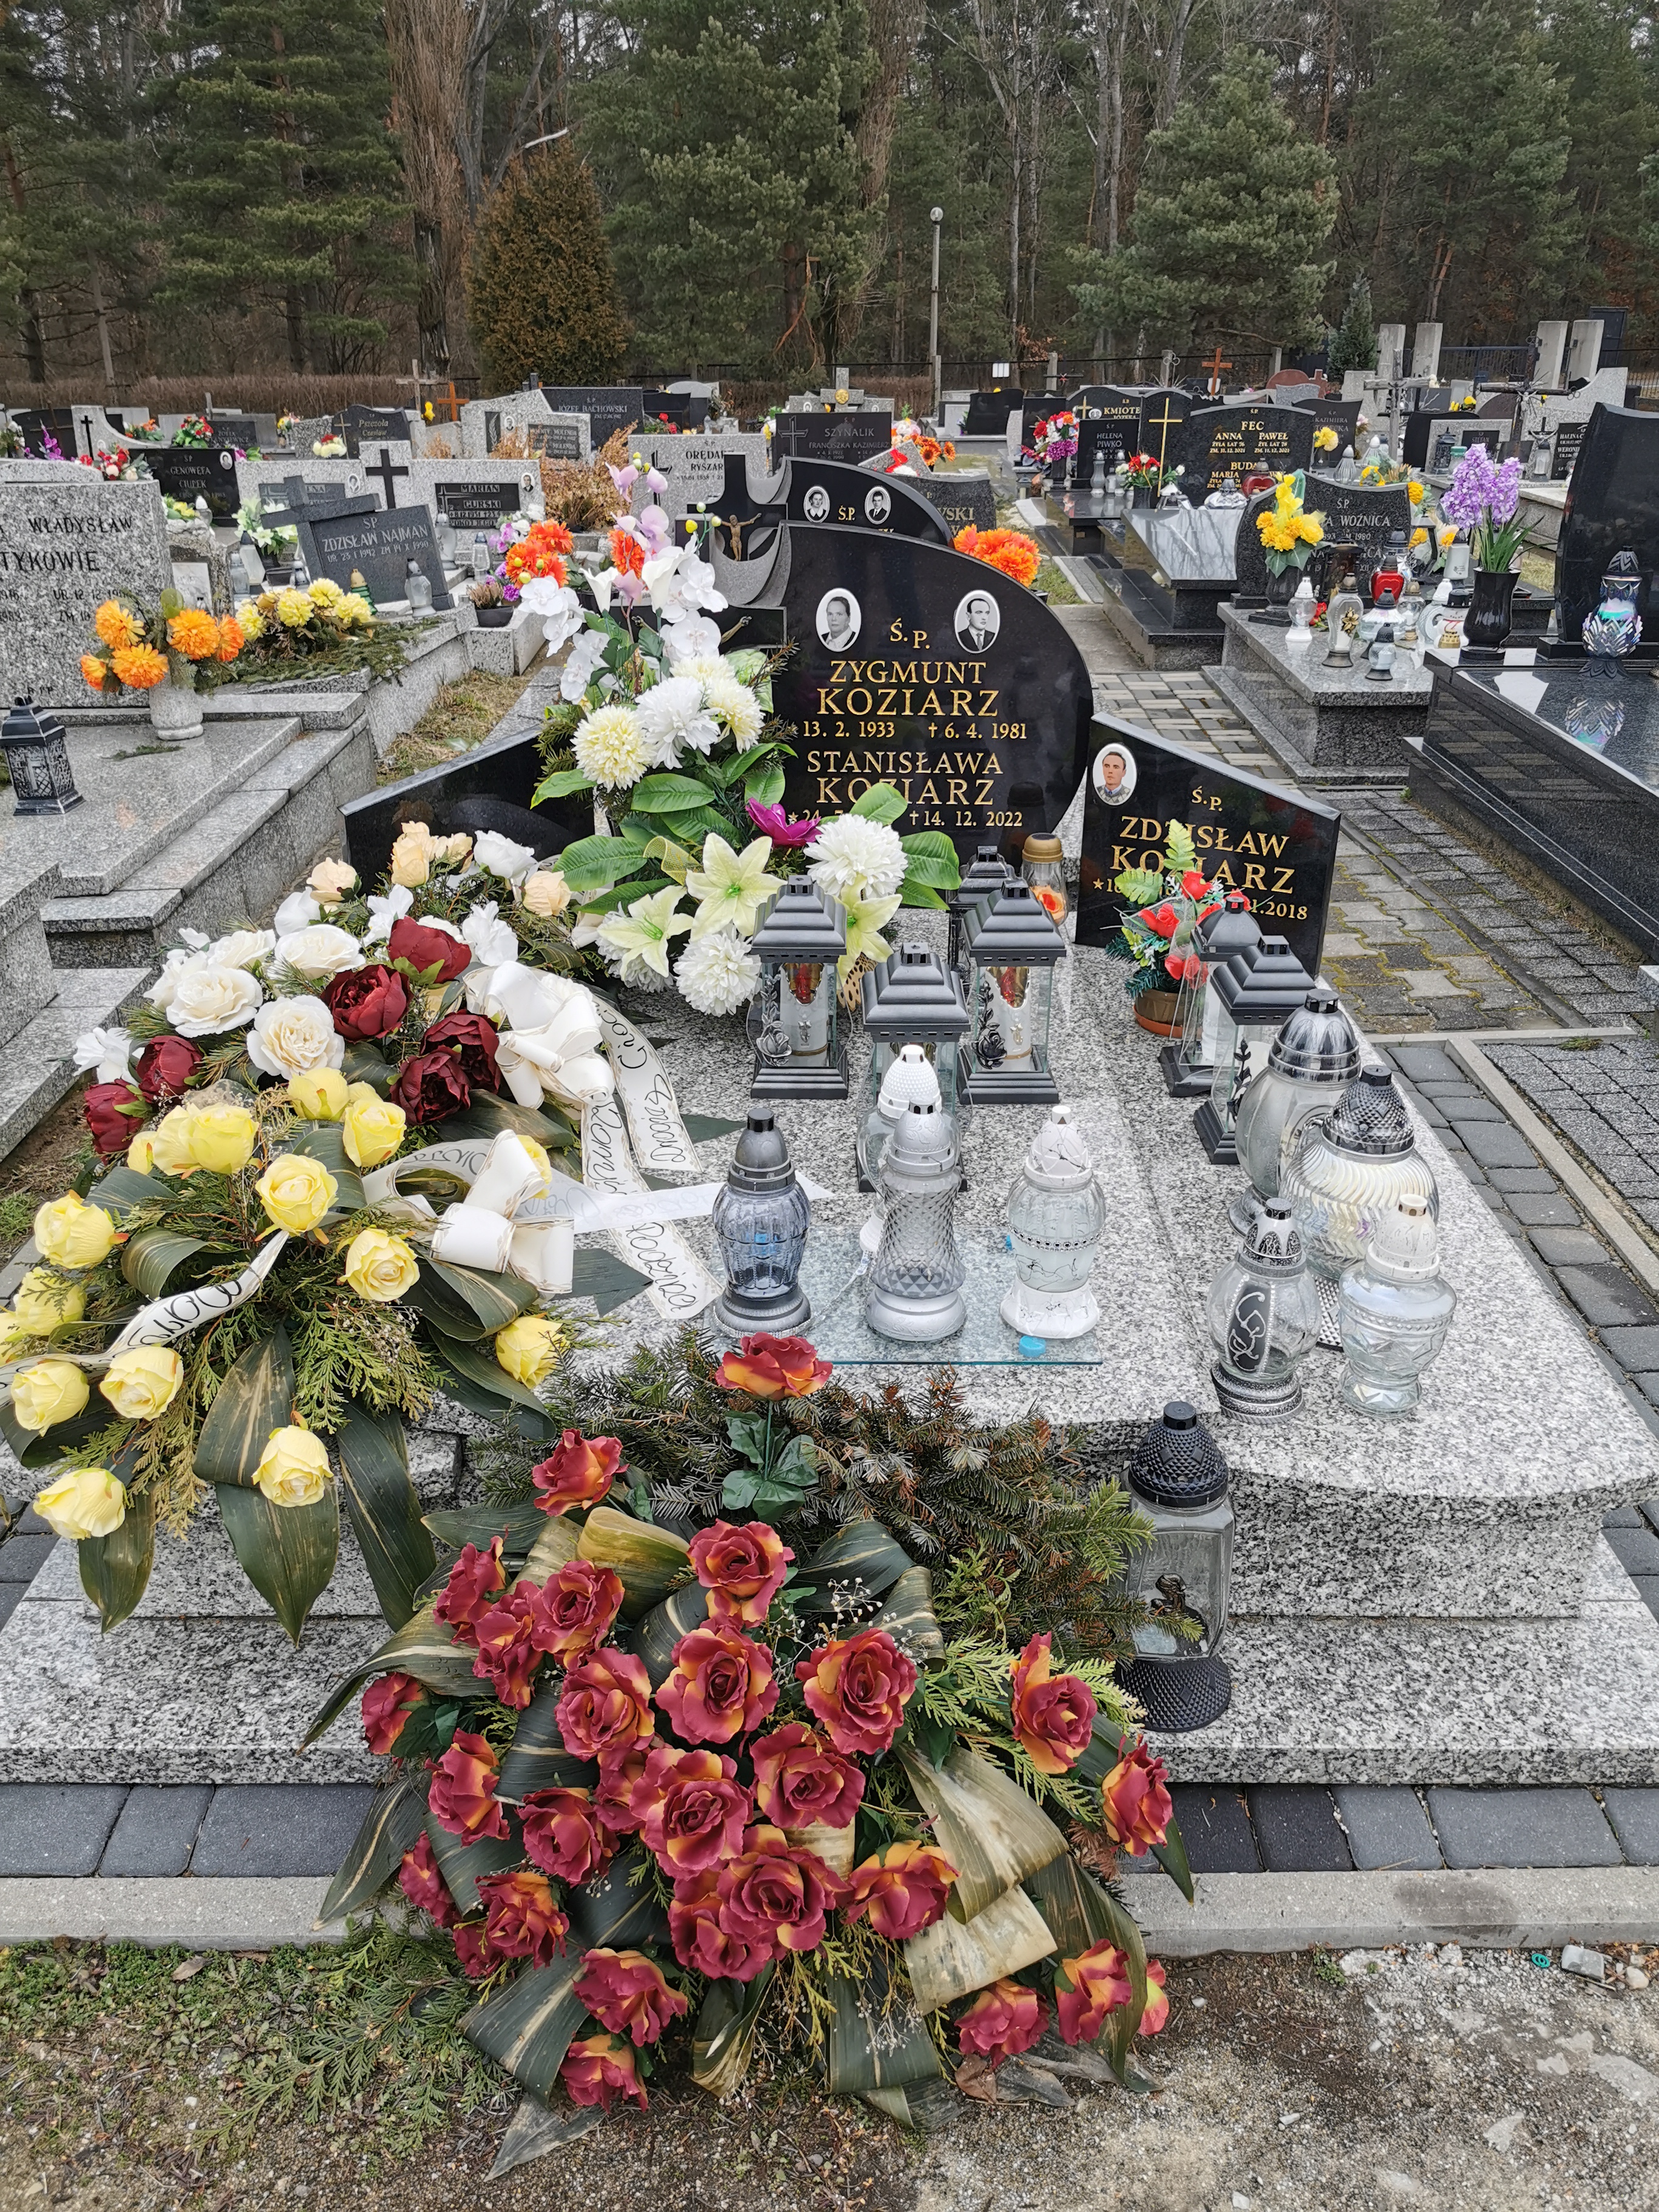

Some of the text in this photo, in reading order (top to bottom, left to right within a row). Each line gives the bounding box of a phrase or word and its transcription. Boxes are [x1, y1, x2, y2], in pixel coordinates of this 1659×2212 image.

[824, 428, 875, 437] SZYNALIK
[1241, 421, 1265, 431] FEC
[1258, 432, 1289, 440] PAWEŁ
[461, 484, 500, 493] MARIAN
[838, 505, 856, 521] Ś.P.
[1340, 515, 1391, 527] WOŹNICA
[28, 516, 132, 534] WŁADYSŁAW
[322, 524, 429, 552] ZDZISŁAW NAJMAN
[829, 660, 987, 685] ZYGMUNT
[816, 688, 1000, 717] KOZIARZ
[803, 720, 827, 737] 13.
[834, 720, 850, 737] 2.
[859, 721, 896, 738] 1933
[991, 723, 1027, 740] 1981
[806, 750, 1004, 775] STANISŁAWA
[816, 777, 994, 806] KOIARZ
[923, 810, 945, 826] 14.
[955, 811, 977, 827] 12.
[985, 811, 1023, 827] 2022
[1109, 845, 1296, 894] KOIARZ
[1251, 899, 1308, 920] 1.2018
